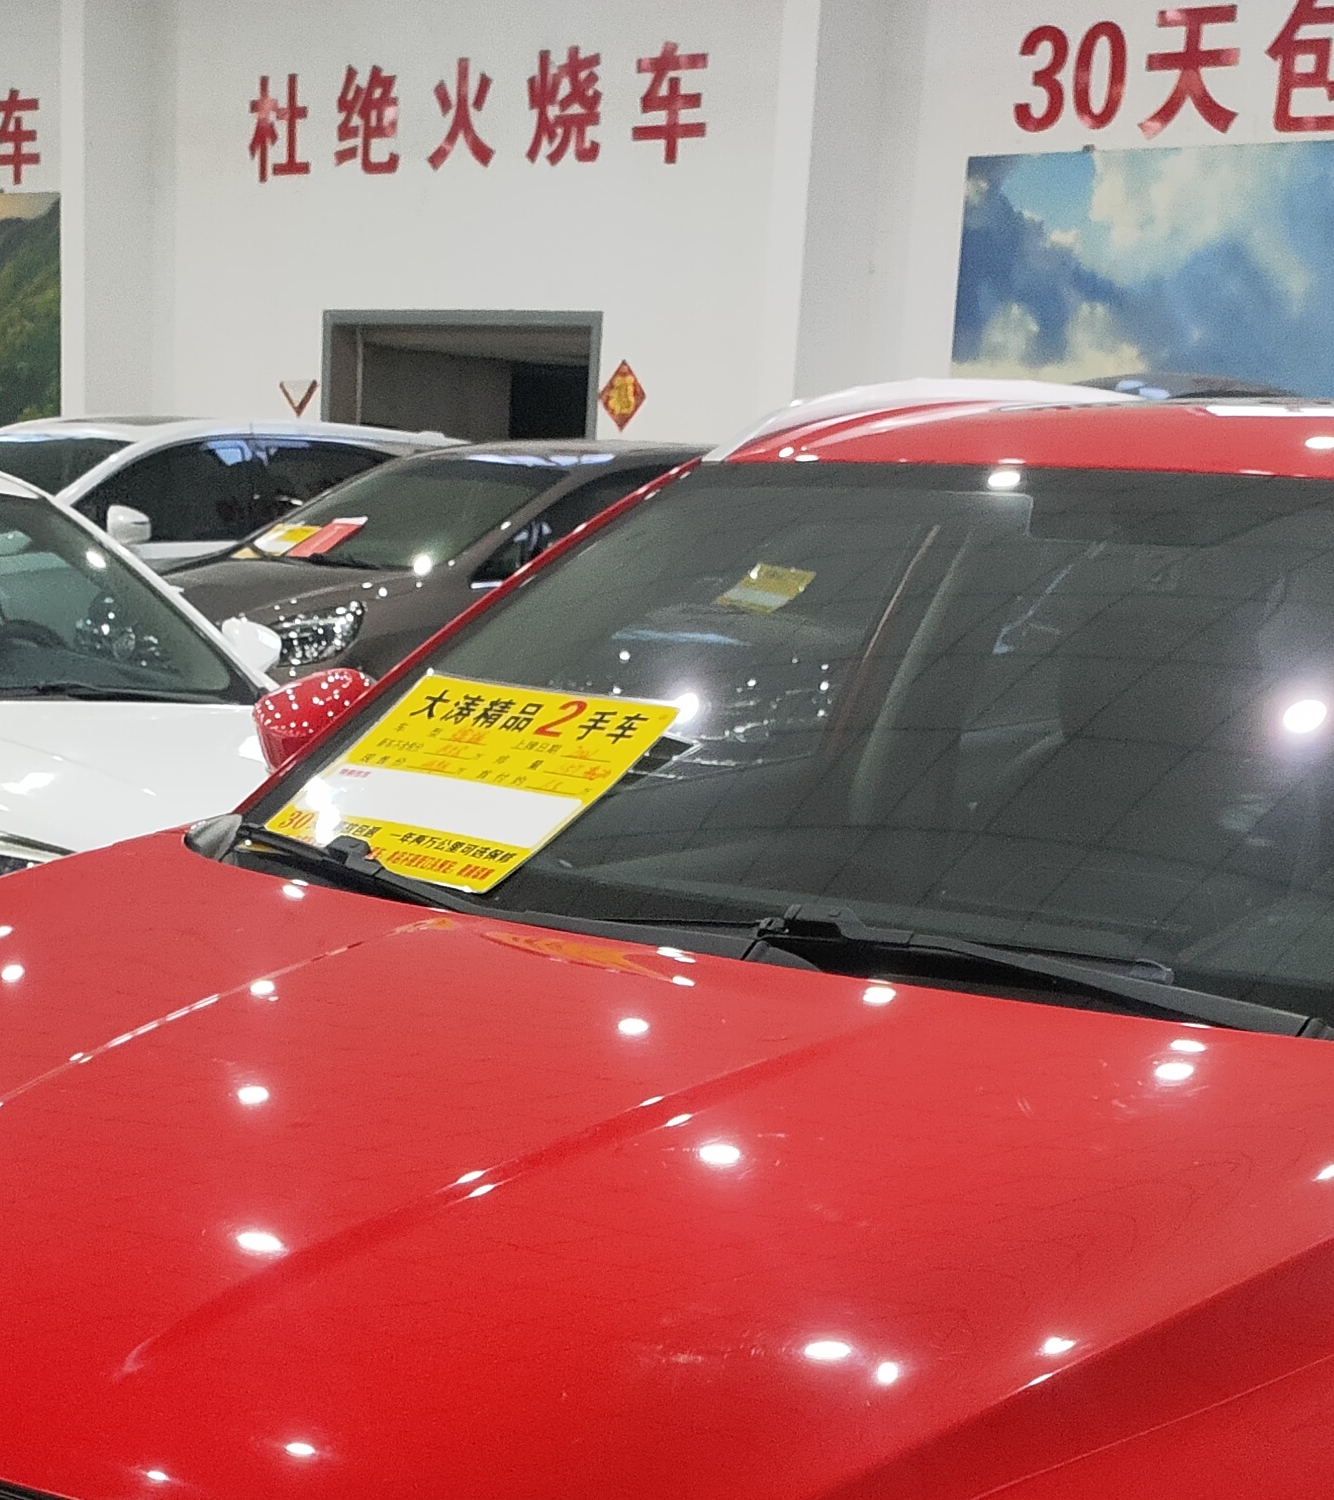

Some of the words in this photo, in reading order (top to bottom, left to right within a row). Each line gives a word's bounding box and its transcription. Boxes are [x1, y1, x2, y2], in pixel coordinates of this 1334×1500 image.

[248, 40, 709, 183] 杜绝火烧车
[410, 689, 649, 746] 大涛精品2手车
